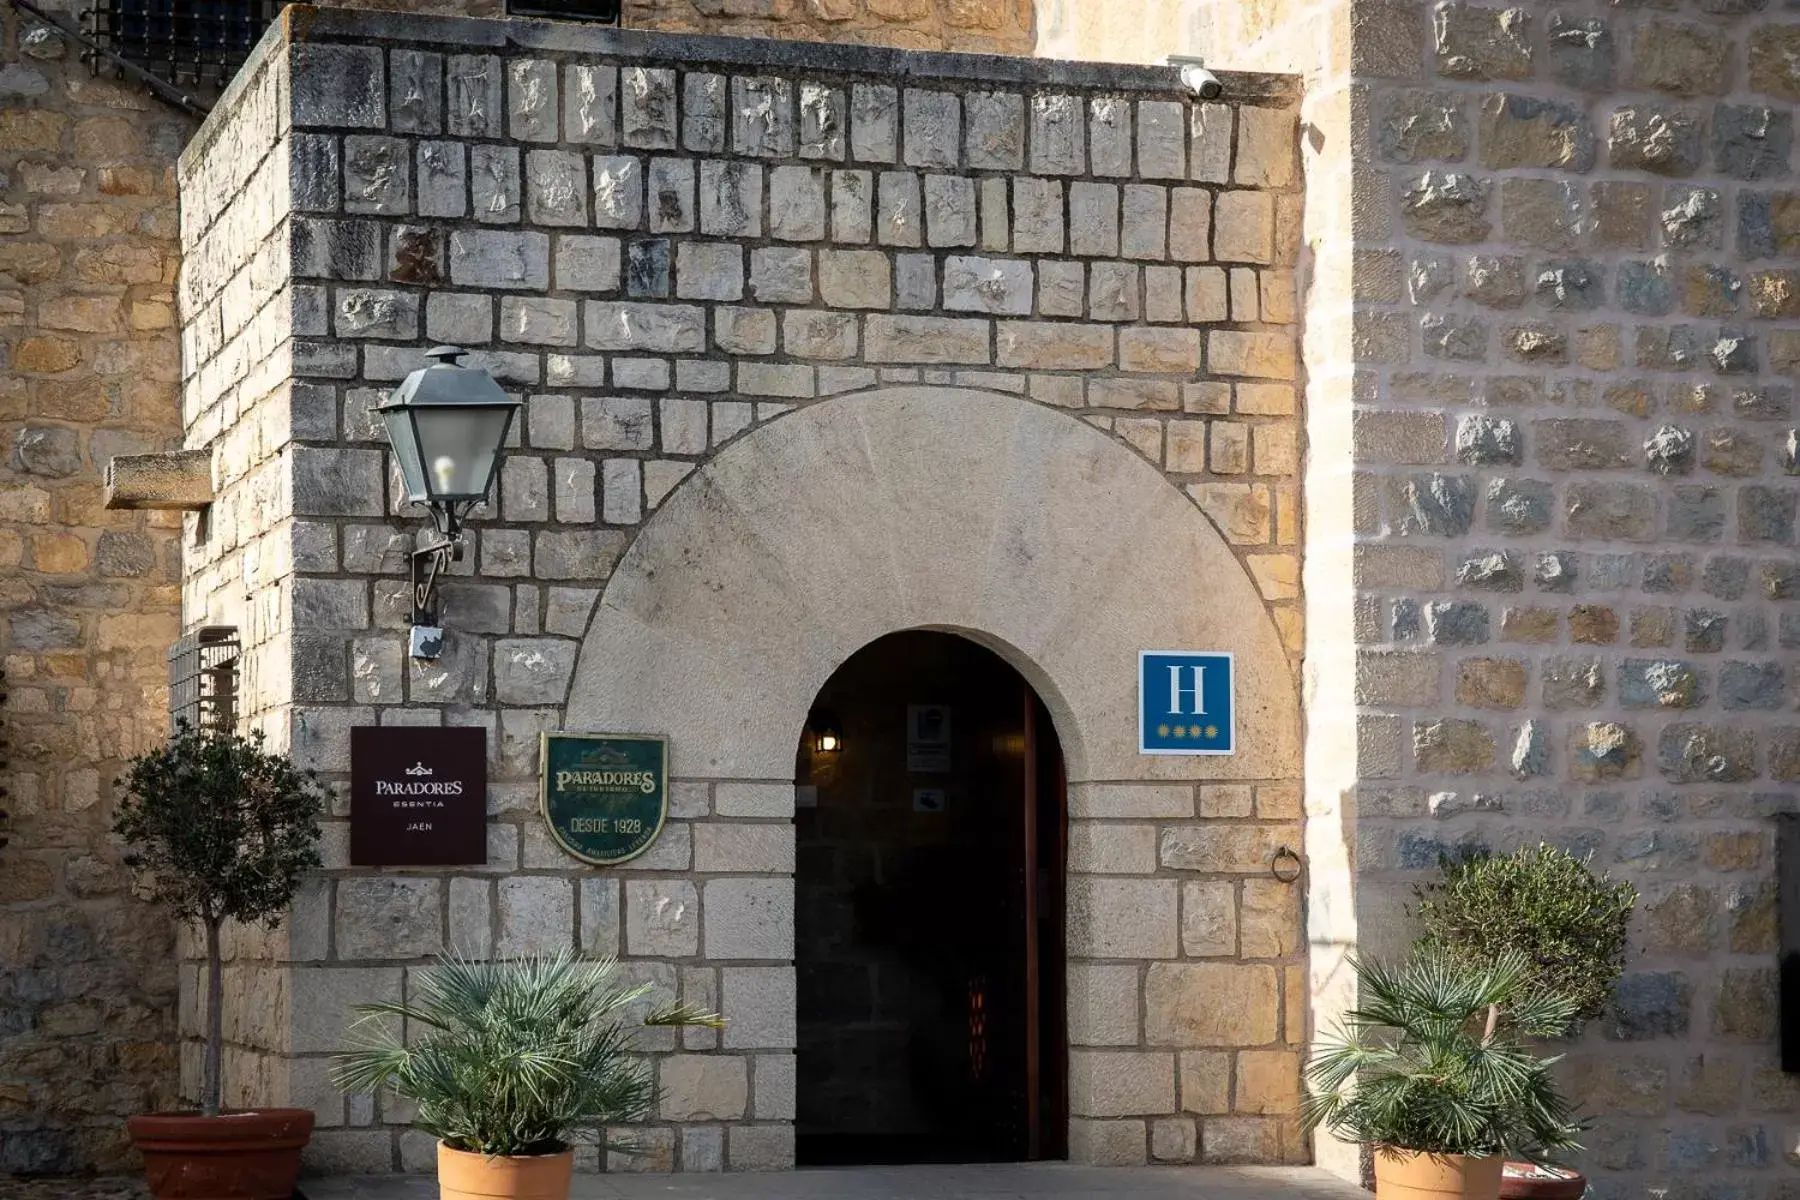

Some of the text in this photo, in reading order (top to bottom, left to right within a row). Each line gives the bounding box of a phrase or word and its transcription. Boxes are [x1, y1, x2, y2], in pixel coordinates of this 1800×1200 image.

[1166, 665, 1209, 715] H
[376, 780, 463, 795] PARADORES
[556, 771, 656, 794] PARADORES
[571, 818, 642, 834] DESDE 1928
